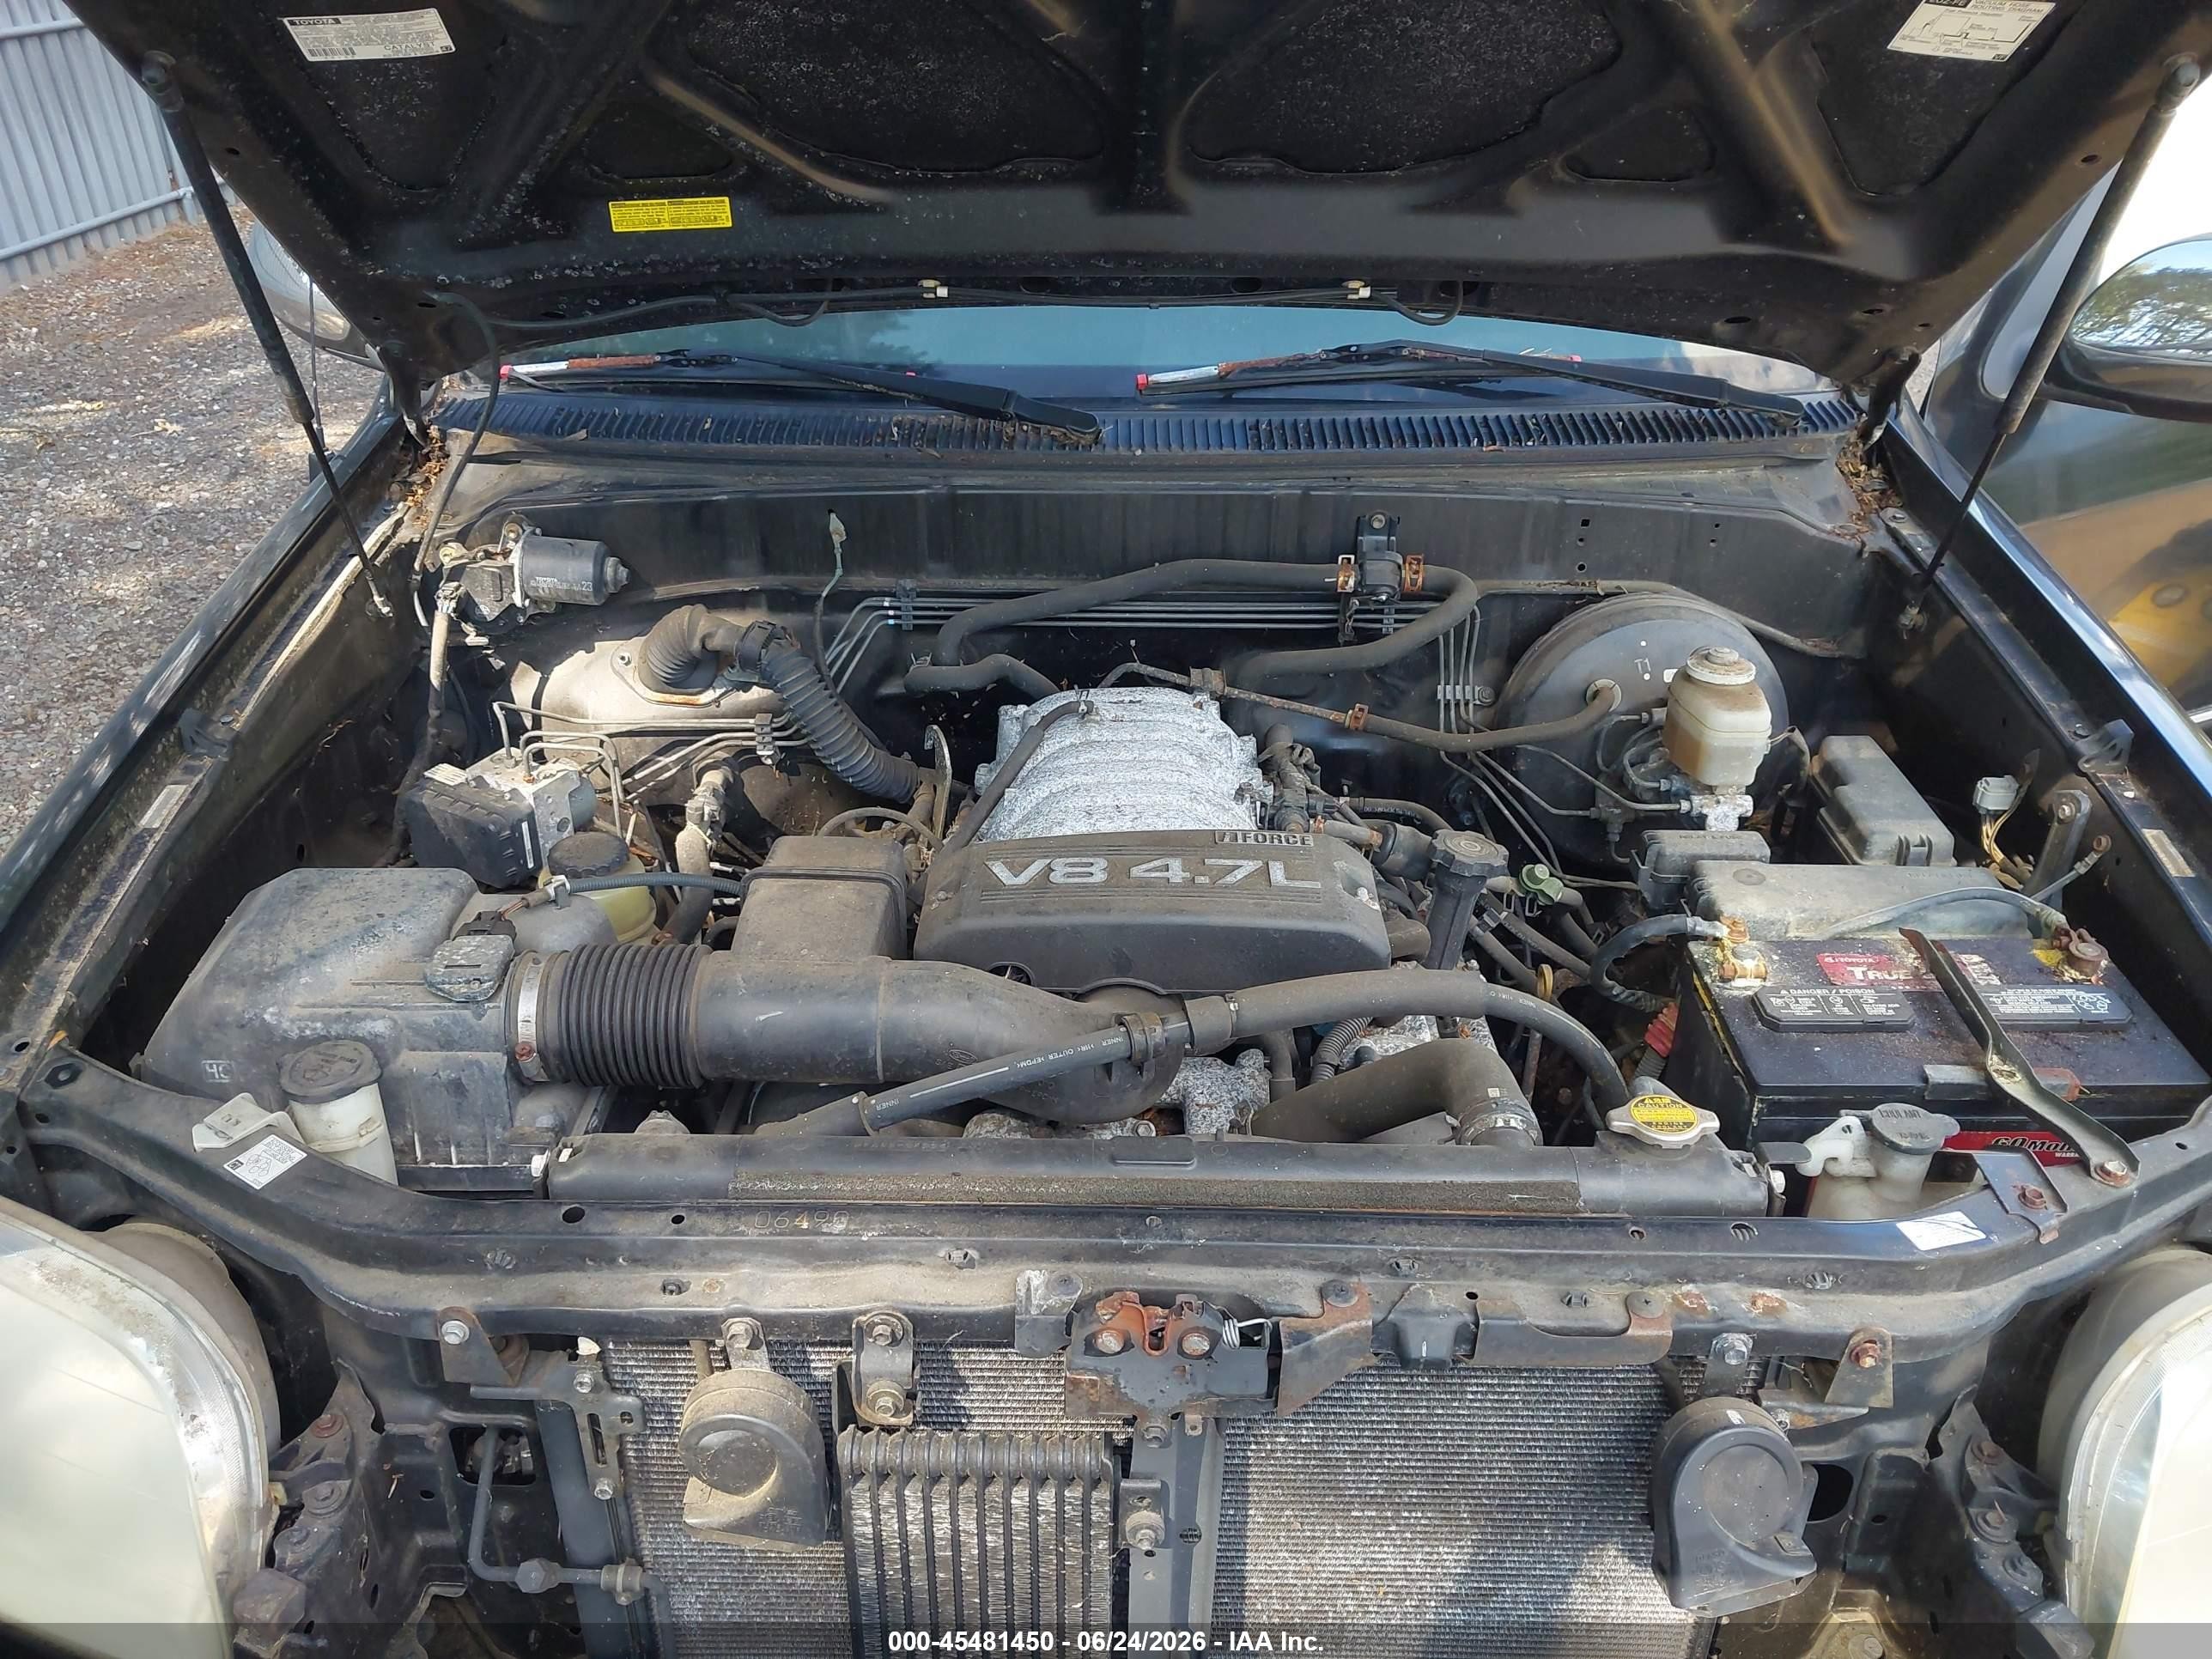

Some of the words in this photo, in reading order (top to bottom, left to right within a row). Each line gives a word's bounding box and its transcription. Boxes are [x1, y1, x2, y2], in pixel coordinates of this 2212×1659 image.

[984, 857, 1109, 887] V8
[1129, 857, 1322, 889] 4.7L
[1101, 1036, 1124, 1047] INNER
[1048, 1048, 1074, 1060] OUTER
[876, 1097, 900, 1111] INNER
